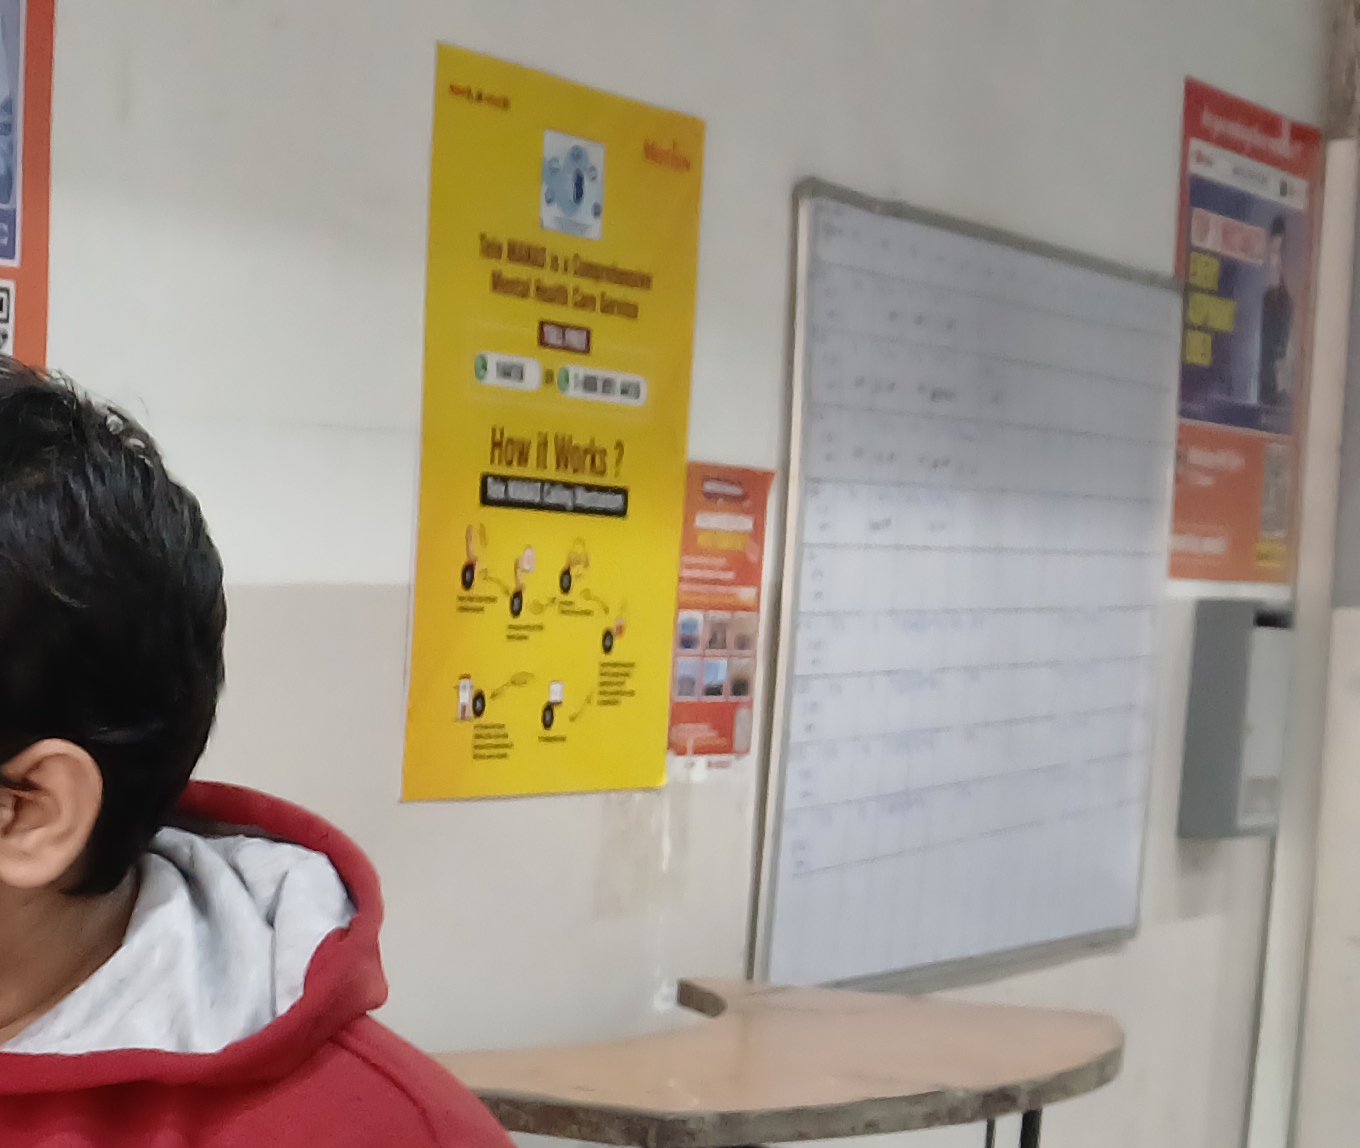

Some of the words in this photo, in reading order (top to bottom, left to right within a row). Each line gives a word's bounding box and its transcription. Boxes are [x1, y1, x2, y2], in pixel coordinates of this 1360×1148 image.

[490, 424, 531, 468] How
[536, 431, 548, 470] it
[554, 431, 607, 476] Works
[614, 439, 625, 477] ?
